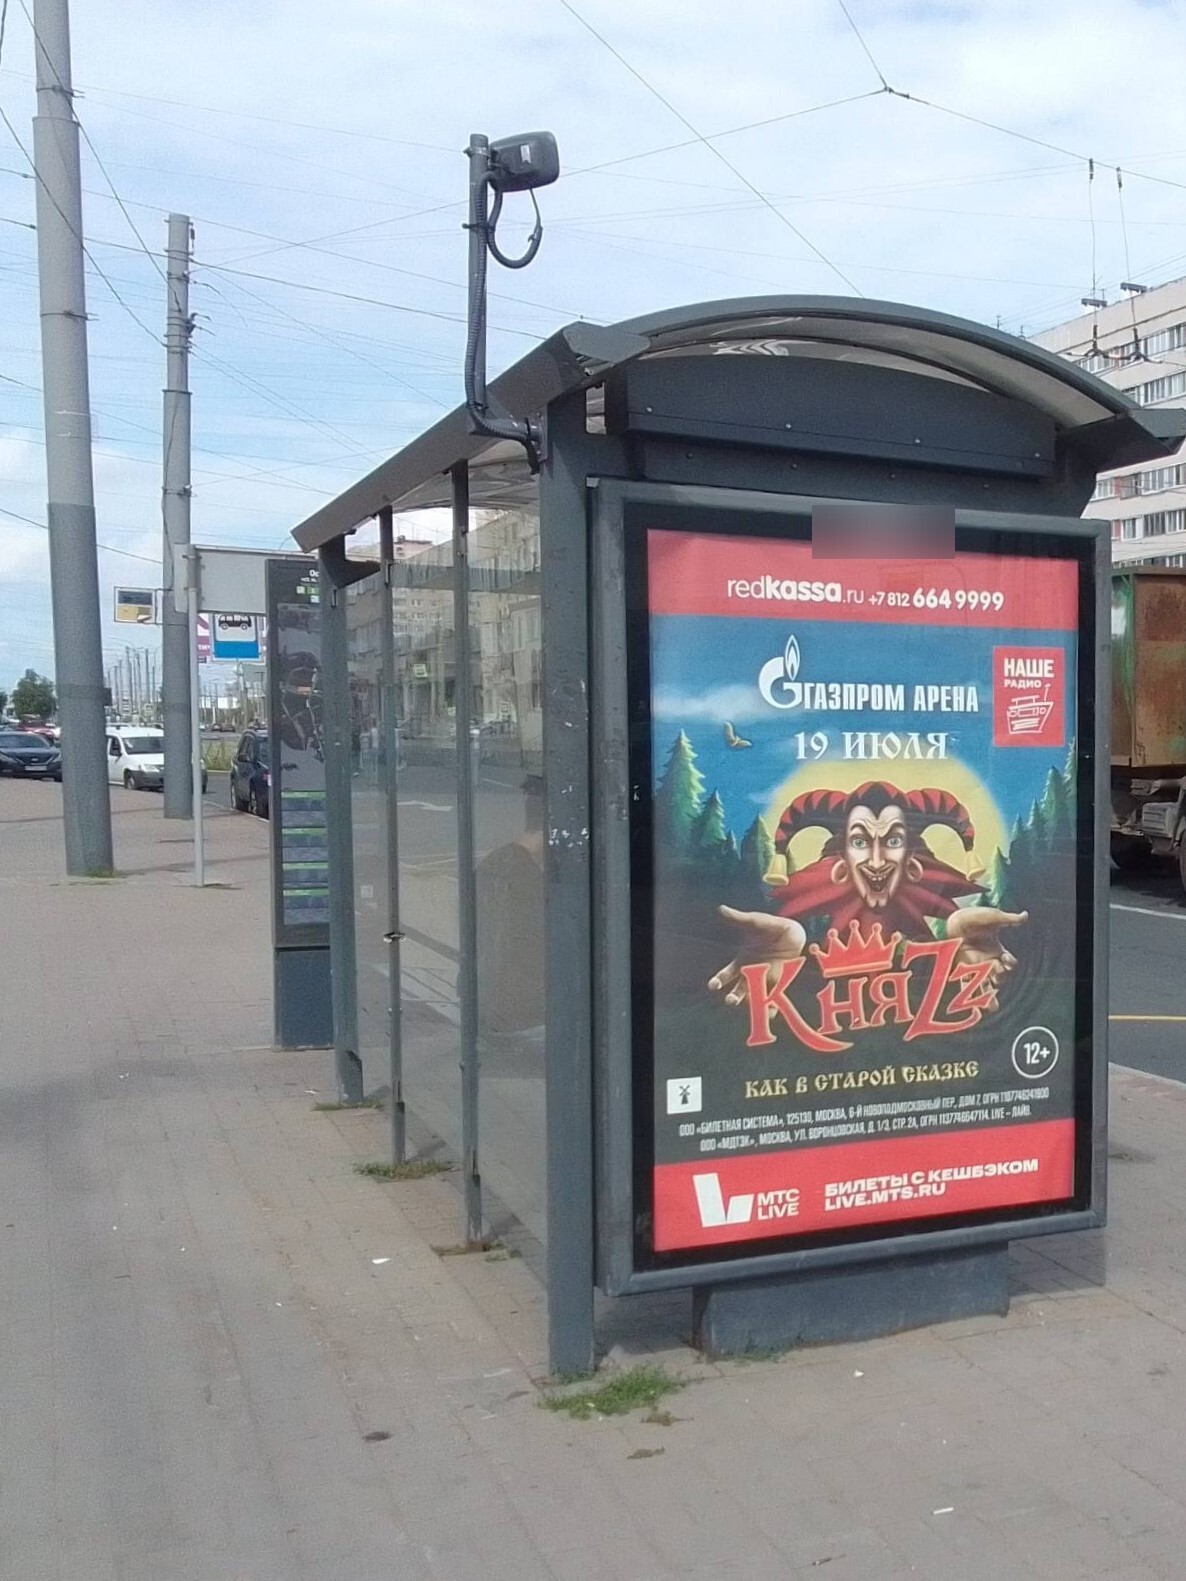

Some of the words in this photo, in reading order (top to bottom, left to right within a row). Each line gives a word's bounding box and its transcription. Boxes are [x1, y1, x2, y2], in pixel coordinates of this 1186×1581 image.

[727, 575, 864, 604] redkassa.ru
[887, 592, 910, 607] 812
[913, 587, 952, 609] 664
[955, 590, 1004, 611] 9999
[1004, 658, 1055, 678] НАШЕ
[803, 682, 905, 711] ГАЗПРОМ
[913, 685, 979, 712] АРЕНА
[1004, 679, 1042, 690] РАДИО
[795, 732, 828, 760] 19
[842, 732, 949, 760] ИЮЛЯ
[1023, 1041, 1050, 1065] 12+
[745, 1078, 788, 1098] КАК
[795, 1076, 808, 1093] В
[815, 1065, 896, 1092] СТАРОЙ
[902, 1060, 979, 1083] СКАЗКЕ
[679, 1123, 695, 1137] ООО
[697, 1118, 742, 1134] «БИЛЕТНАЯ
[815, 1107, 847, 1121] МОСКВА,
[700, 1138, 716, 1152] ООО
[759, 1130, 793, 1145] МОСКВА,
[920, 1114, 938, 1127] ОГРН
[825, 1173, 908, 1197] БИЛЕТЫ
[911, 1171, 925, 1185] С
[928, 1159, 1039, 1183] КЕШБЭКОМ
[757, 1188, 800, 1206] МТС
[825, 1183, 946, 1211] LIVE.MTS.RU
[757, 1202, 800, 1221] LIVE
